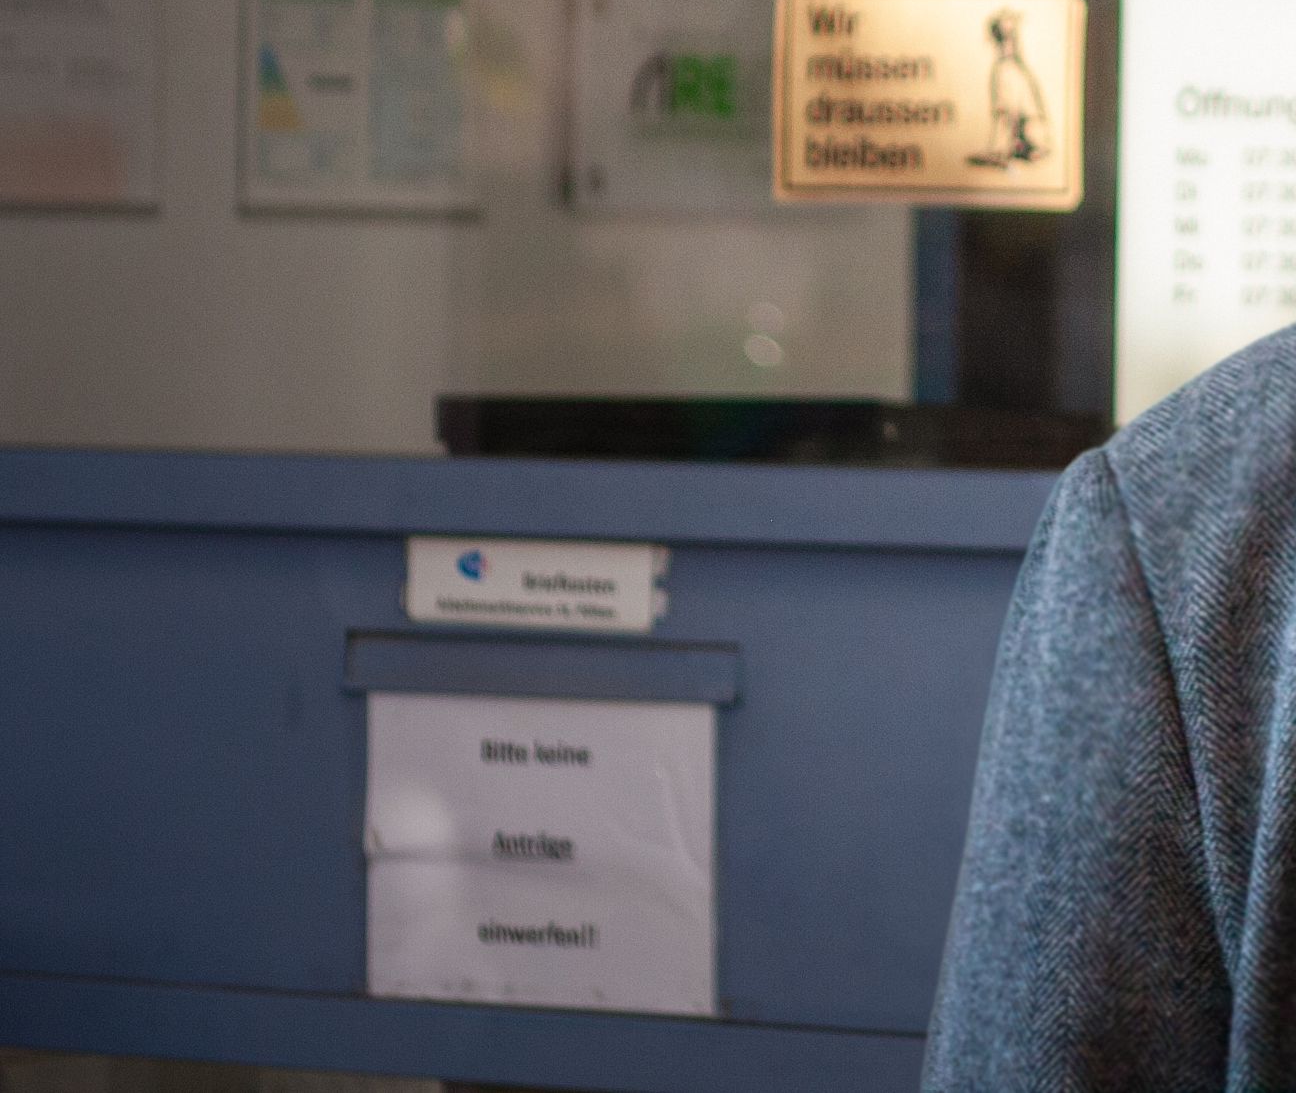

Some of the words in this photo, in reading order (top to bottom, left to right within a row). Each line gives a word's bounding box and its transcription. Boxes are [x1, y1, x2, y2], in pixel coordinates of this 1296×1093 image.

[808, 6, 858, 36] Wir
[806, 49, 933, 82] müssen
[806, 93, 957, 125] draussen
[806, 136, 924, 171] bleiben
[481, 739, 528, 765] Bitte
[533, 741, 592, 767] keine
[493, 830, 575, 862] Anträge
